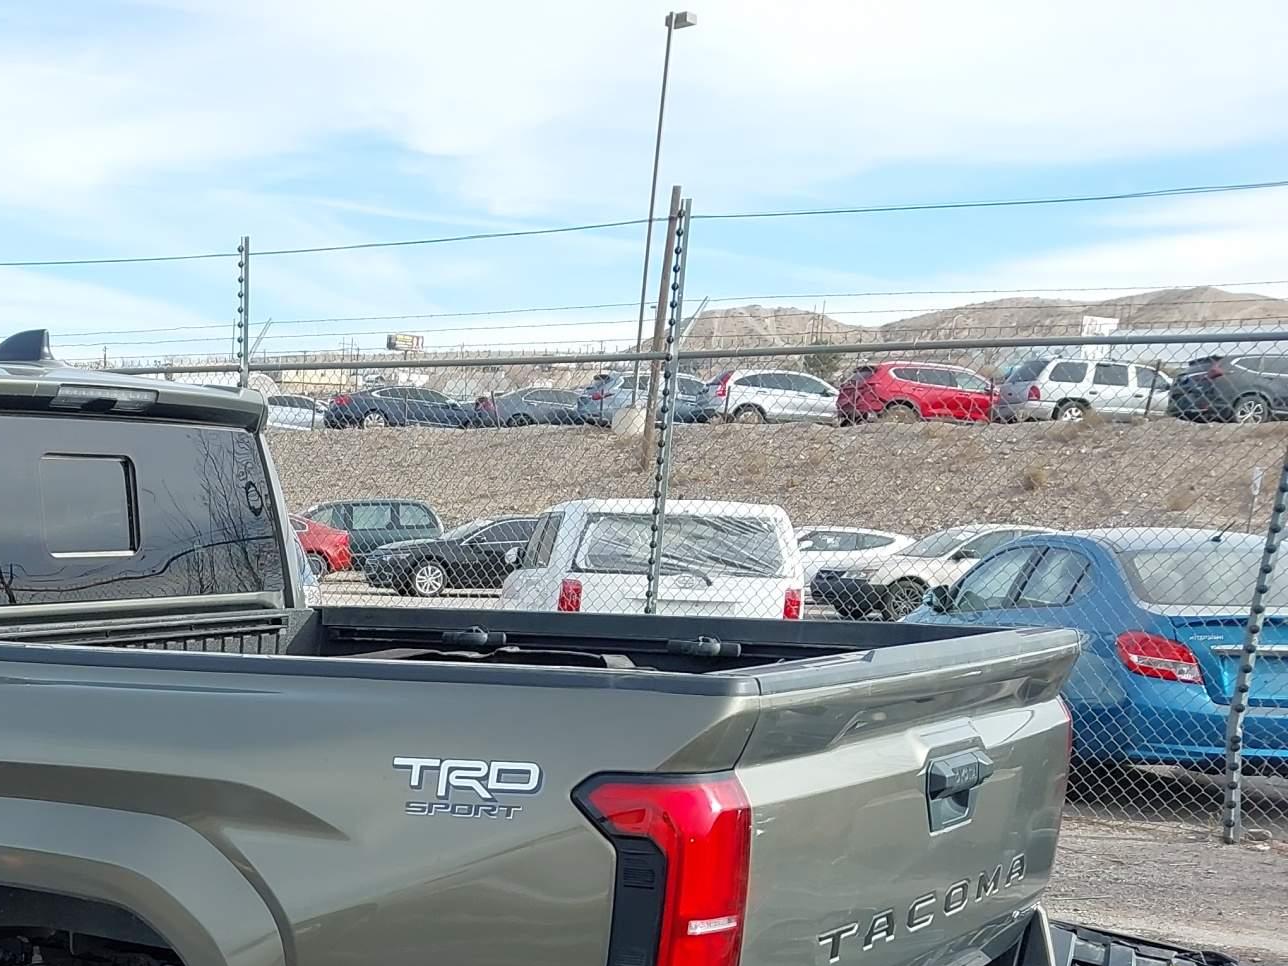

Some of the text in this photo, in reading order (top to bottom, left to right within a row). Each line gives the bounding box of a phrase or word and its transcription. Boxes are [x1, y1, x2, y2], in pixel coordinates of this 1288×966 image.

[392, 756, 543, 803] TRD
[405, 801, 523, 819] SPORT
[818, 852, 1027, 963] TACOMA
